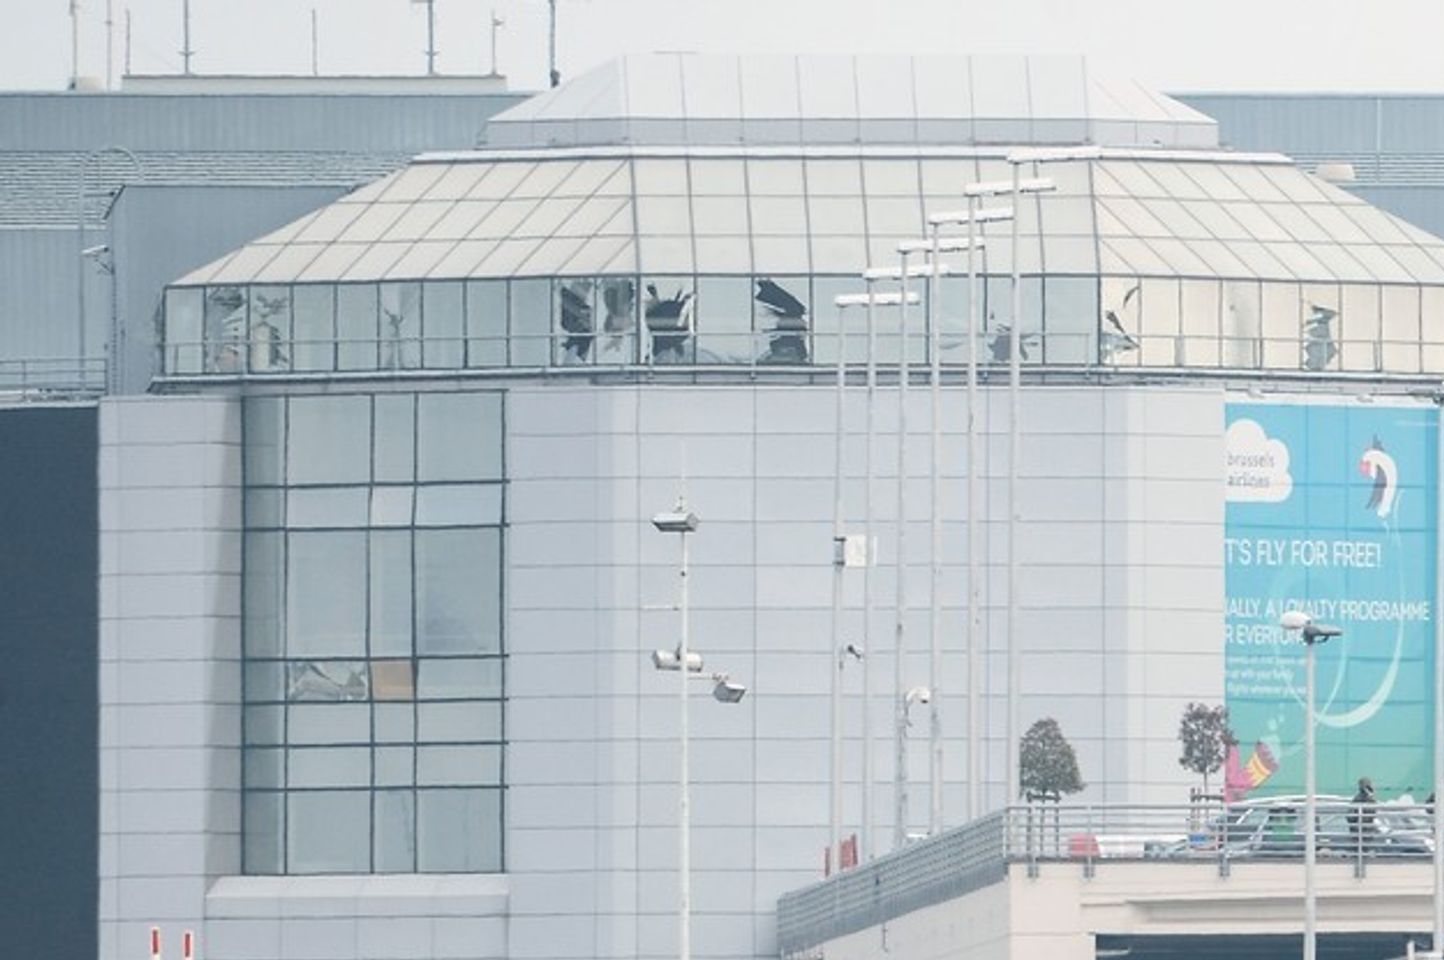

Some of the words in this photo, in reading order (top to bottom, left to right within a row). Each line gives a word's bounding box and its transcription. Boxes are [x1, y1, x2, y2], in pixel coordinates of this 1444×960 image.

[1256, 540, 1286, 566] FLY
[1291, 541, 1328, 567] FOR
[1333, 542, 1382, 569] FREE!
[1265, 599, 1277, 619] A
[1340, 600, 1430, 621] PROGRAMME
